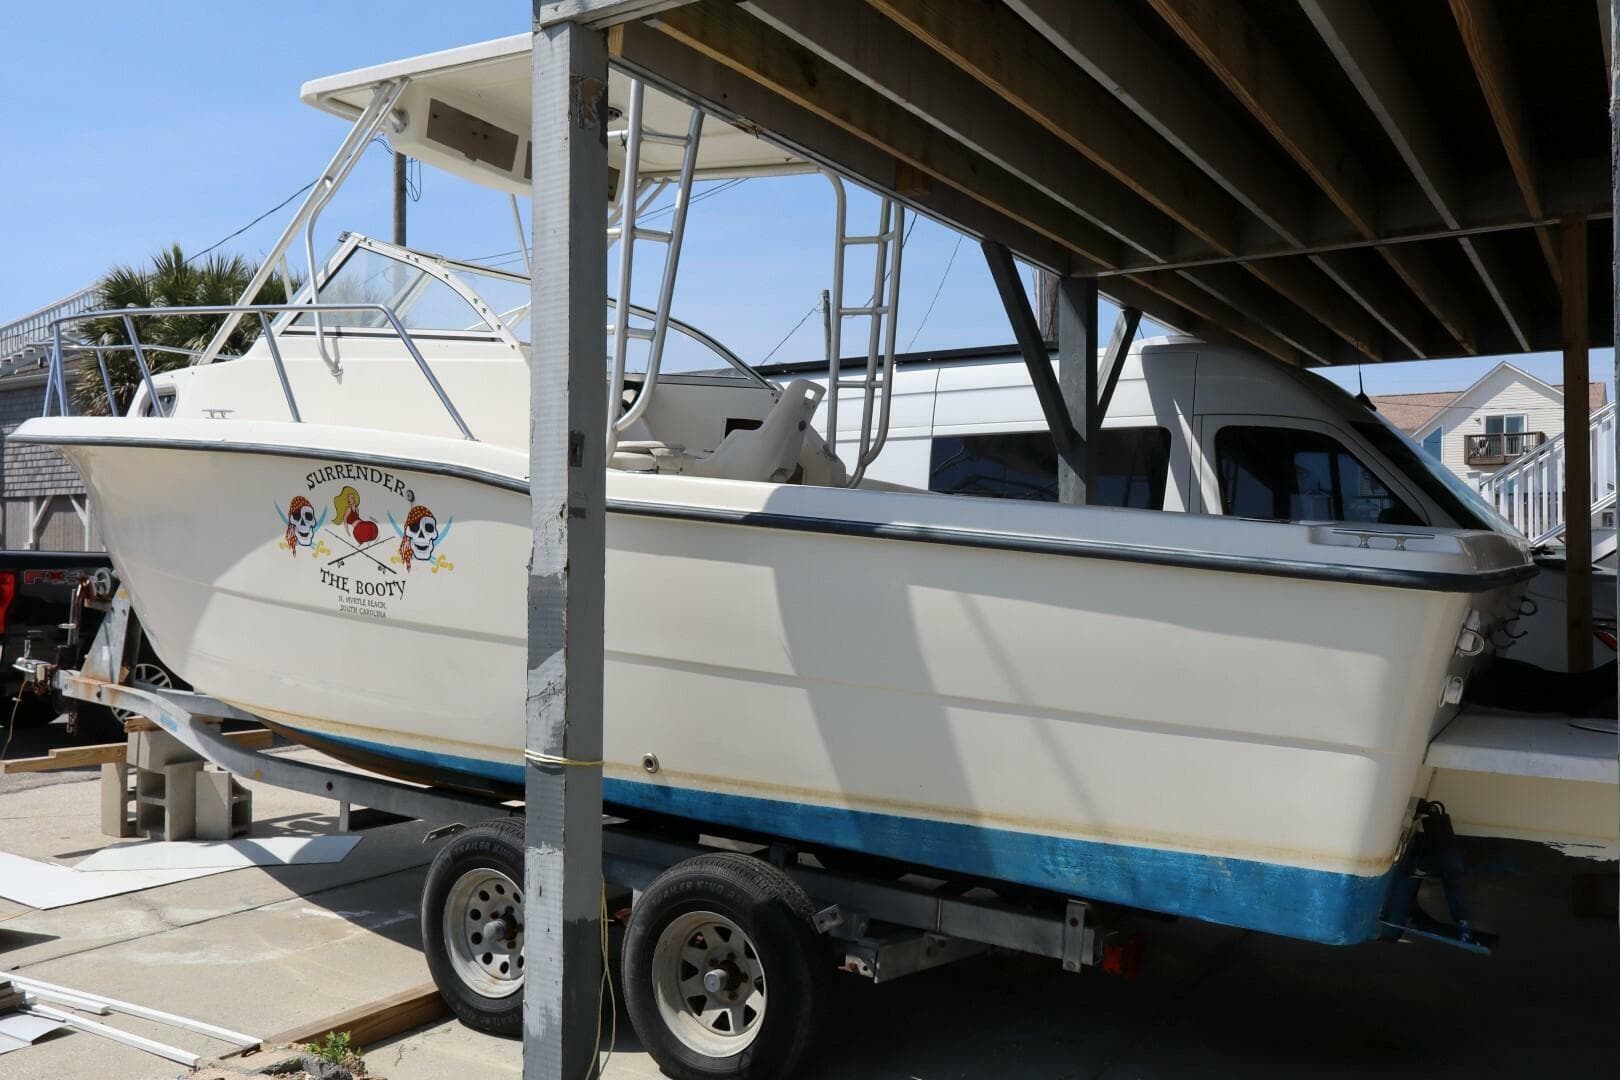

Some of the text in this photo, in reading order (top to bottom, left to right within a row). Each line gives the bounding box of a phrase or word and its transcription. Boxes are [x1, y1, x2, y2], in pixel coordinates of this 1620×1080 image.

[306, 464, 406, 497] SURRENDER
[320, 567, 406, 600] THE BOOTY
[346, 596, 366, 607] MYRTLE
[340, 604, 386, 619] SOUTH CAROLINA
[453, 841, 490, 857] TRAILER
